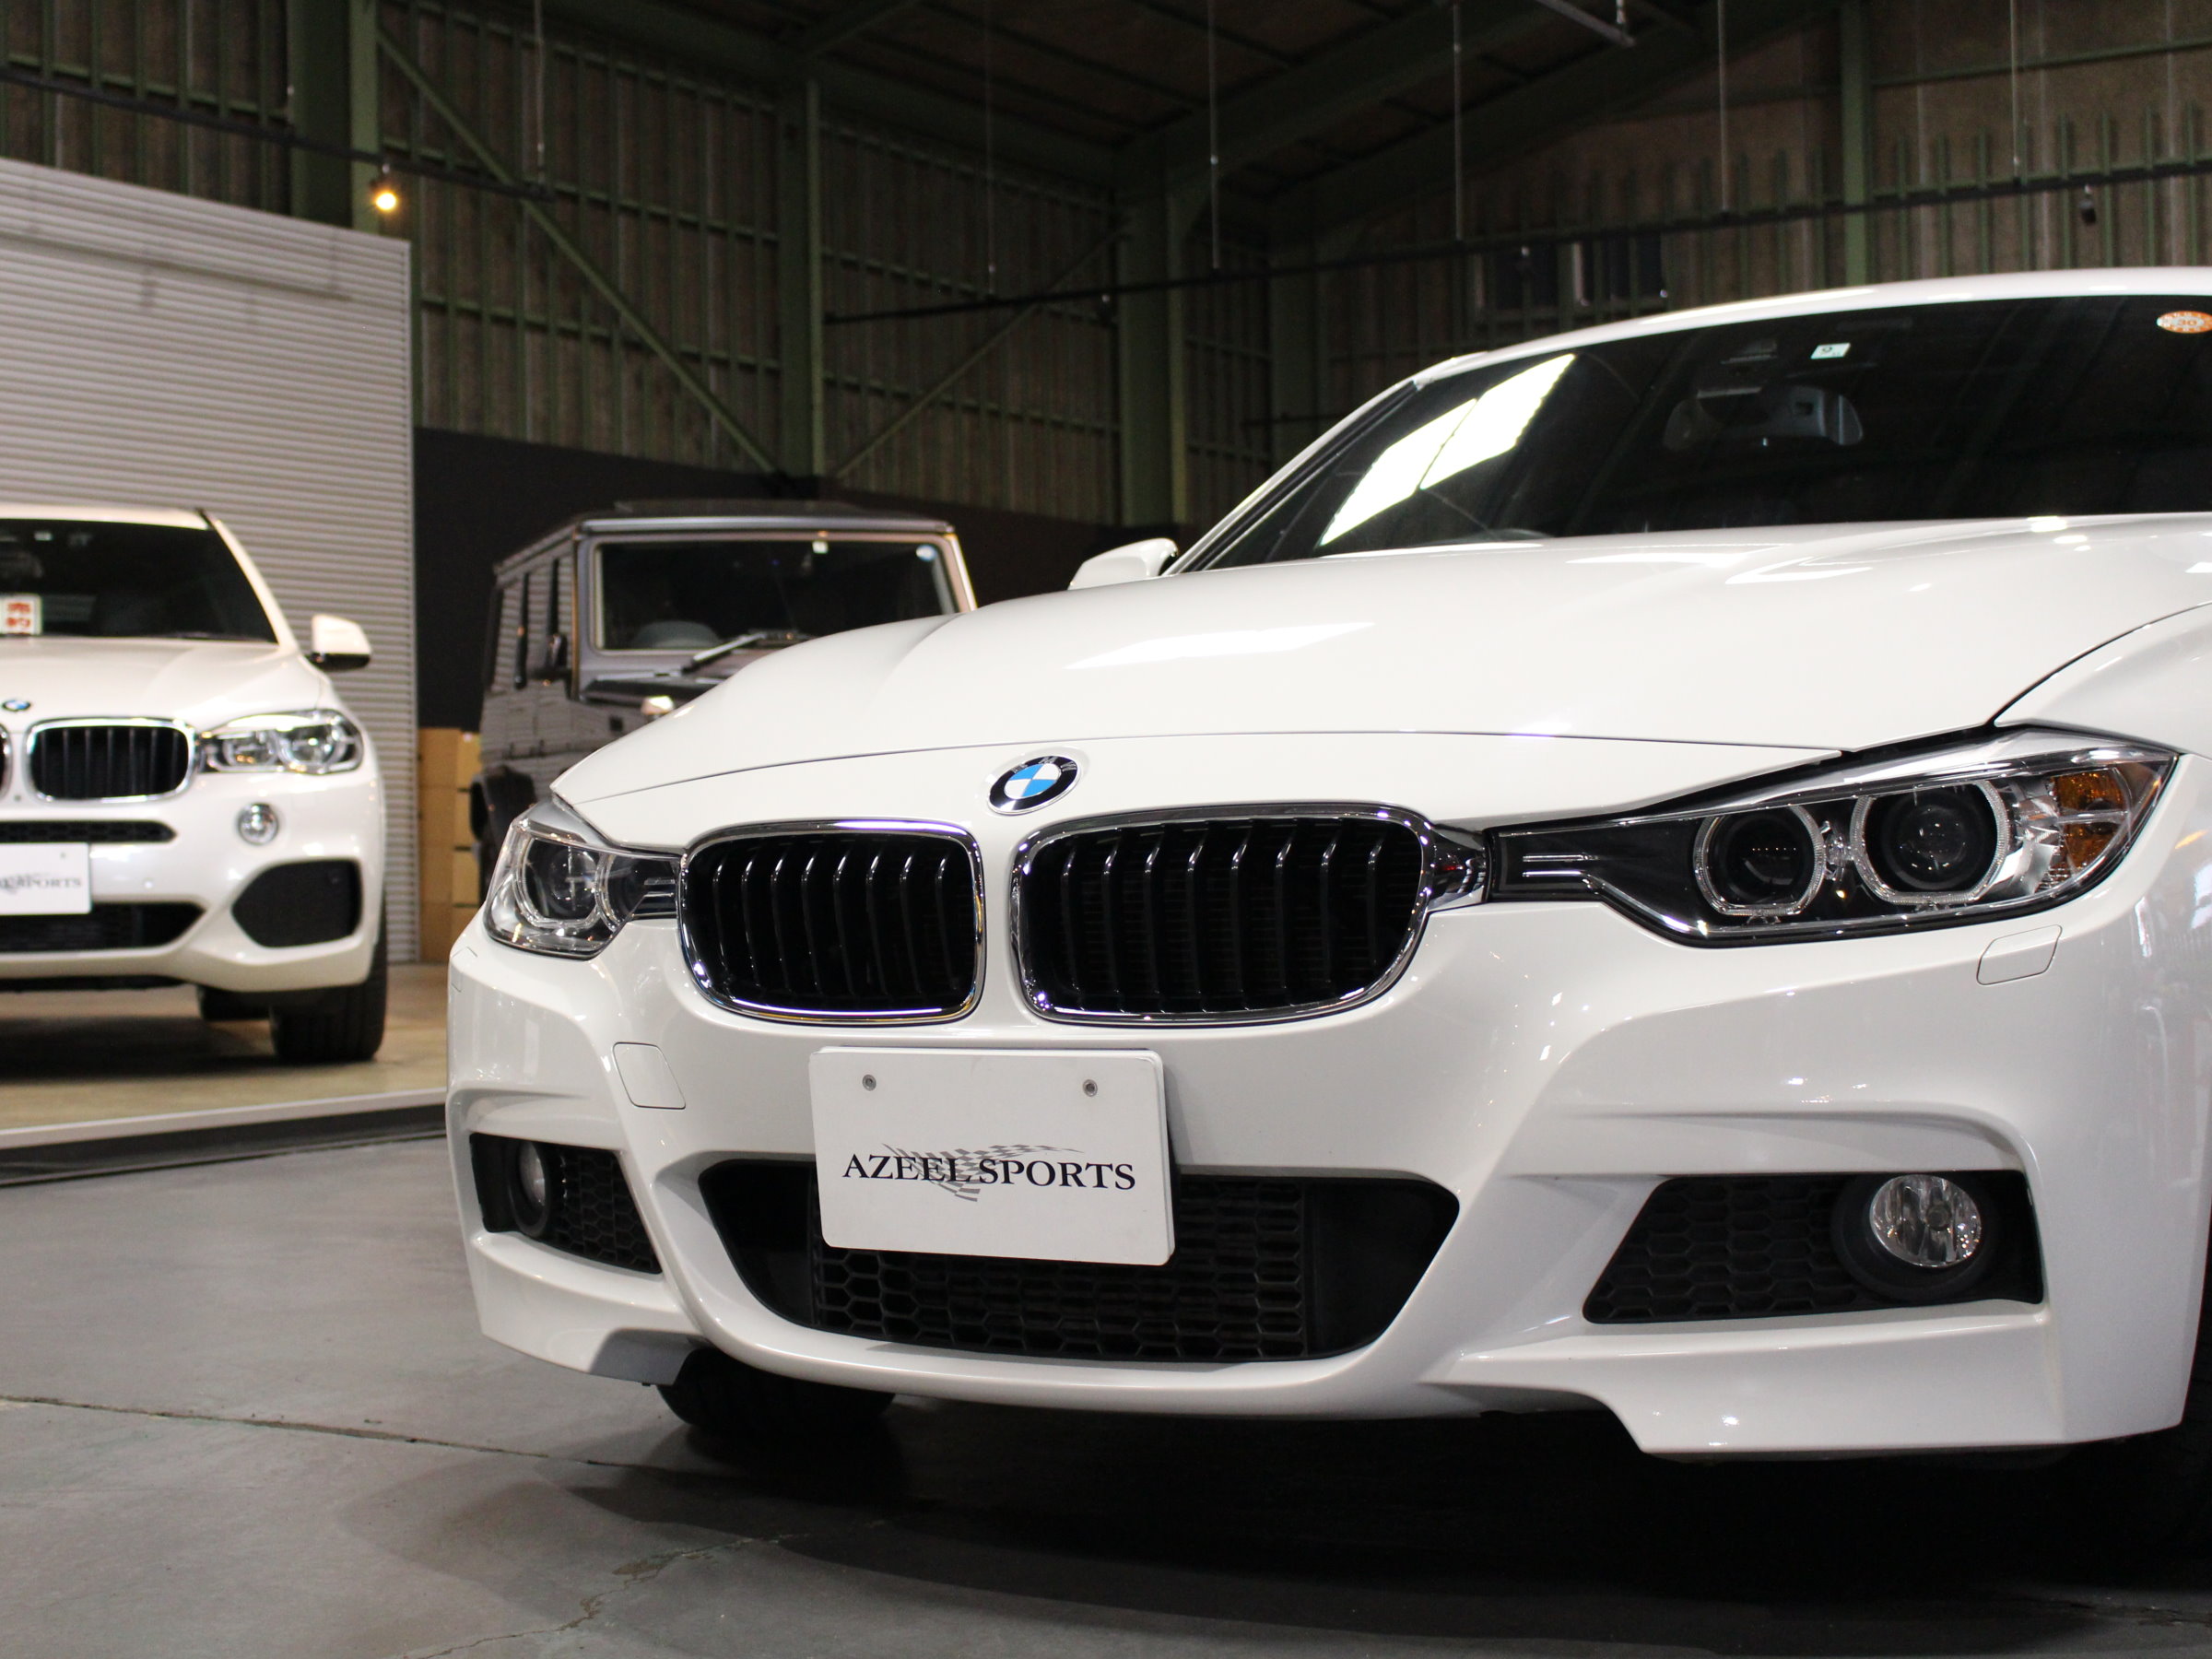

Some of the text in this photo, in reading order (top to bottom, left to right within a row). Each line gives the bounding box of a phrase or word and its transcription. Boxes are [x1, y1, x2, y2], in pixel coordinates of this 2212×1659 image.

[1011, 756, 1077, 773] BMW
[842, 1153, 1136, 1190] AZEEL SPORTS
